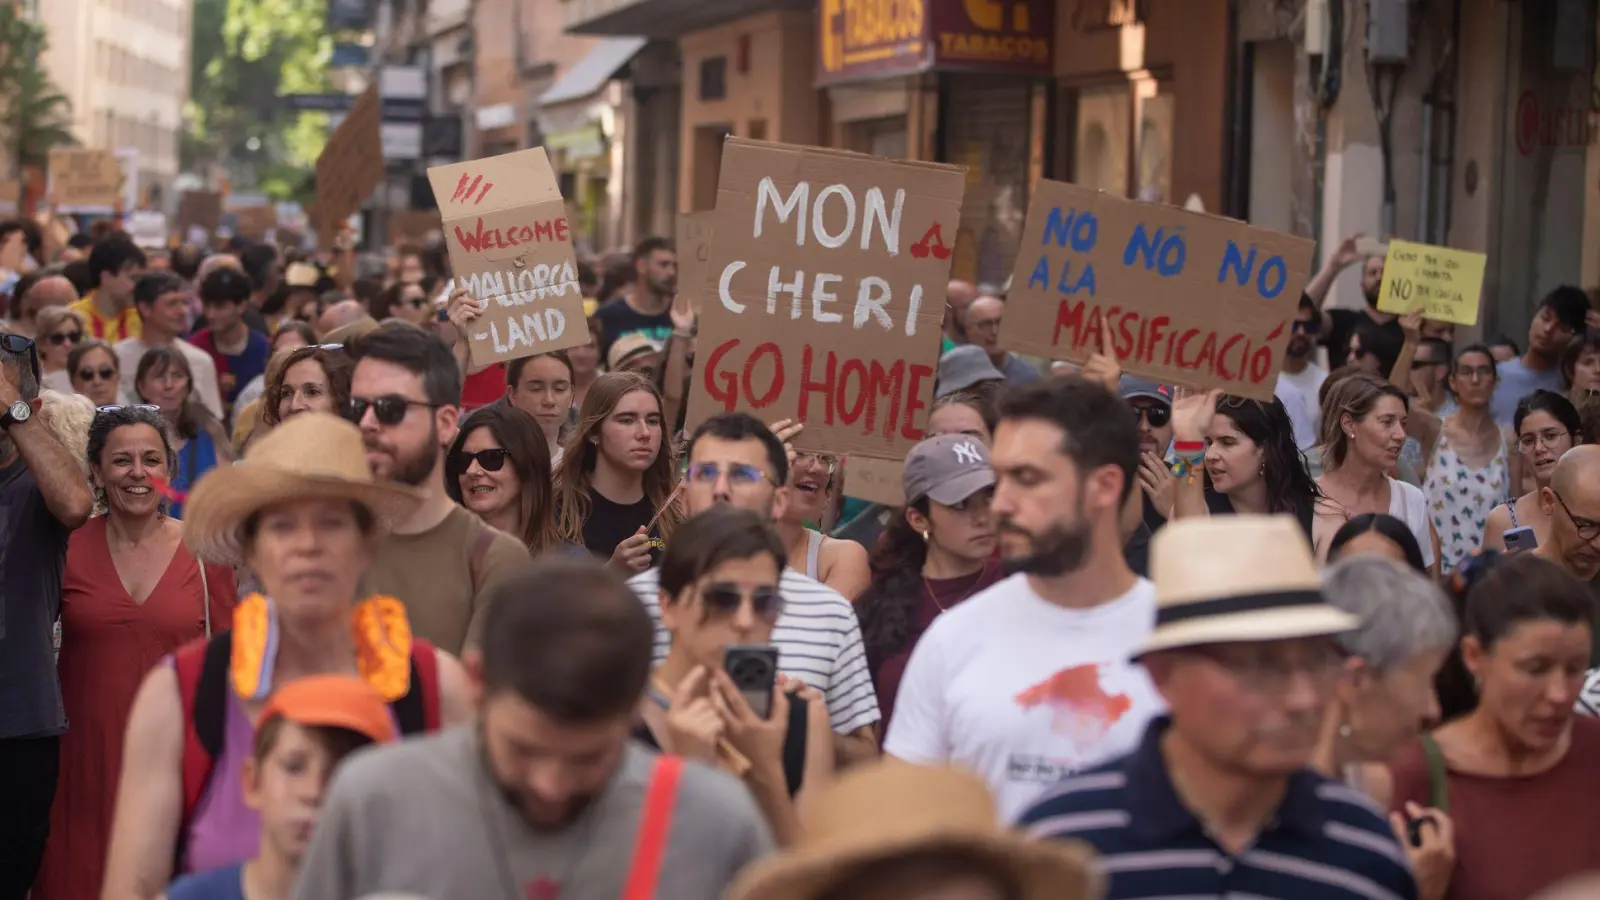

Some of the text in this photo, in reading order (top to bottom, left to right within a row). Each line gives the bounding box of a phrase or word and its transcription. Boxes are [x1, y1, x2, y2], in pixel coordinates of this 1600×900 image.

[454, 217, 569, 252] WELCOME
[753, 176, 906, 257] MON
[1028, 255, 1097, 297] A LA
[1042, 206, 1287, 299] NO NO NO
[459, 259, 580, 309] MALLORCA
[718, 261, 923, 336] CHERI
[1389, 277, 1412, 301] NO
[474, 308, 566, 353] -LAND
[704, 338, 933, 442] GO HOME
